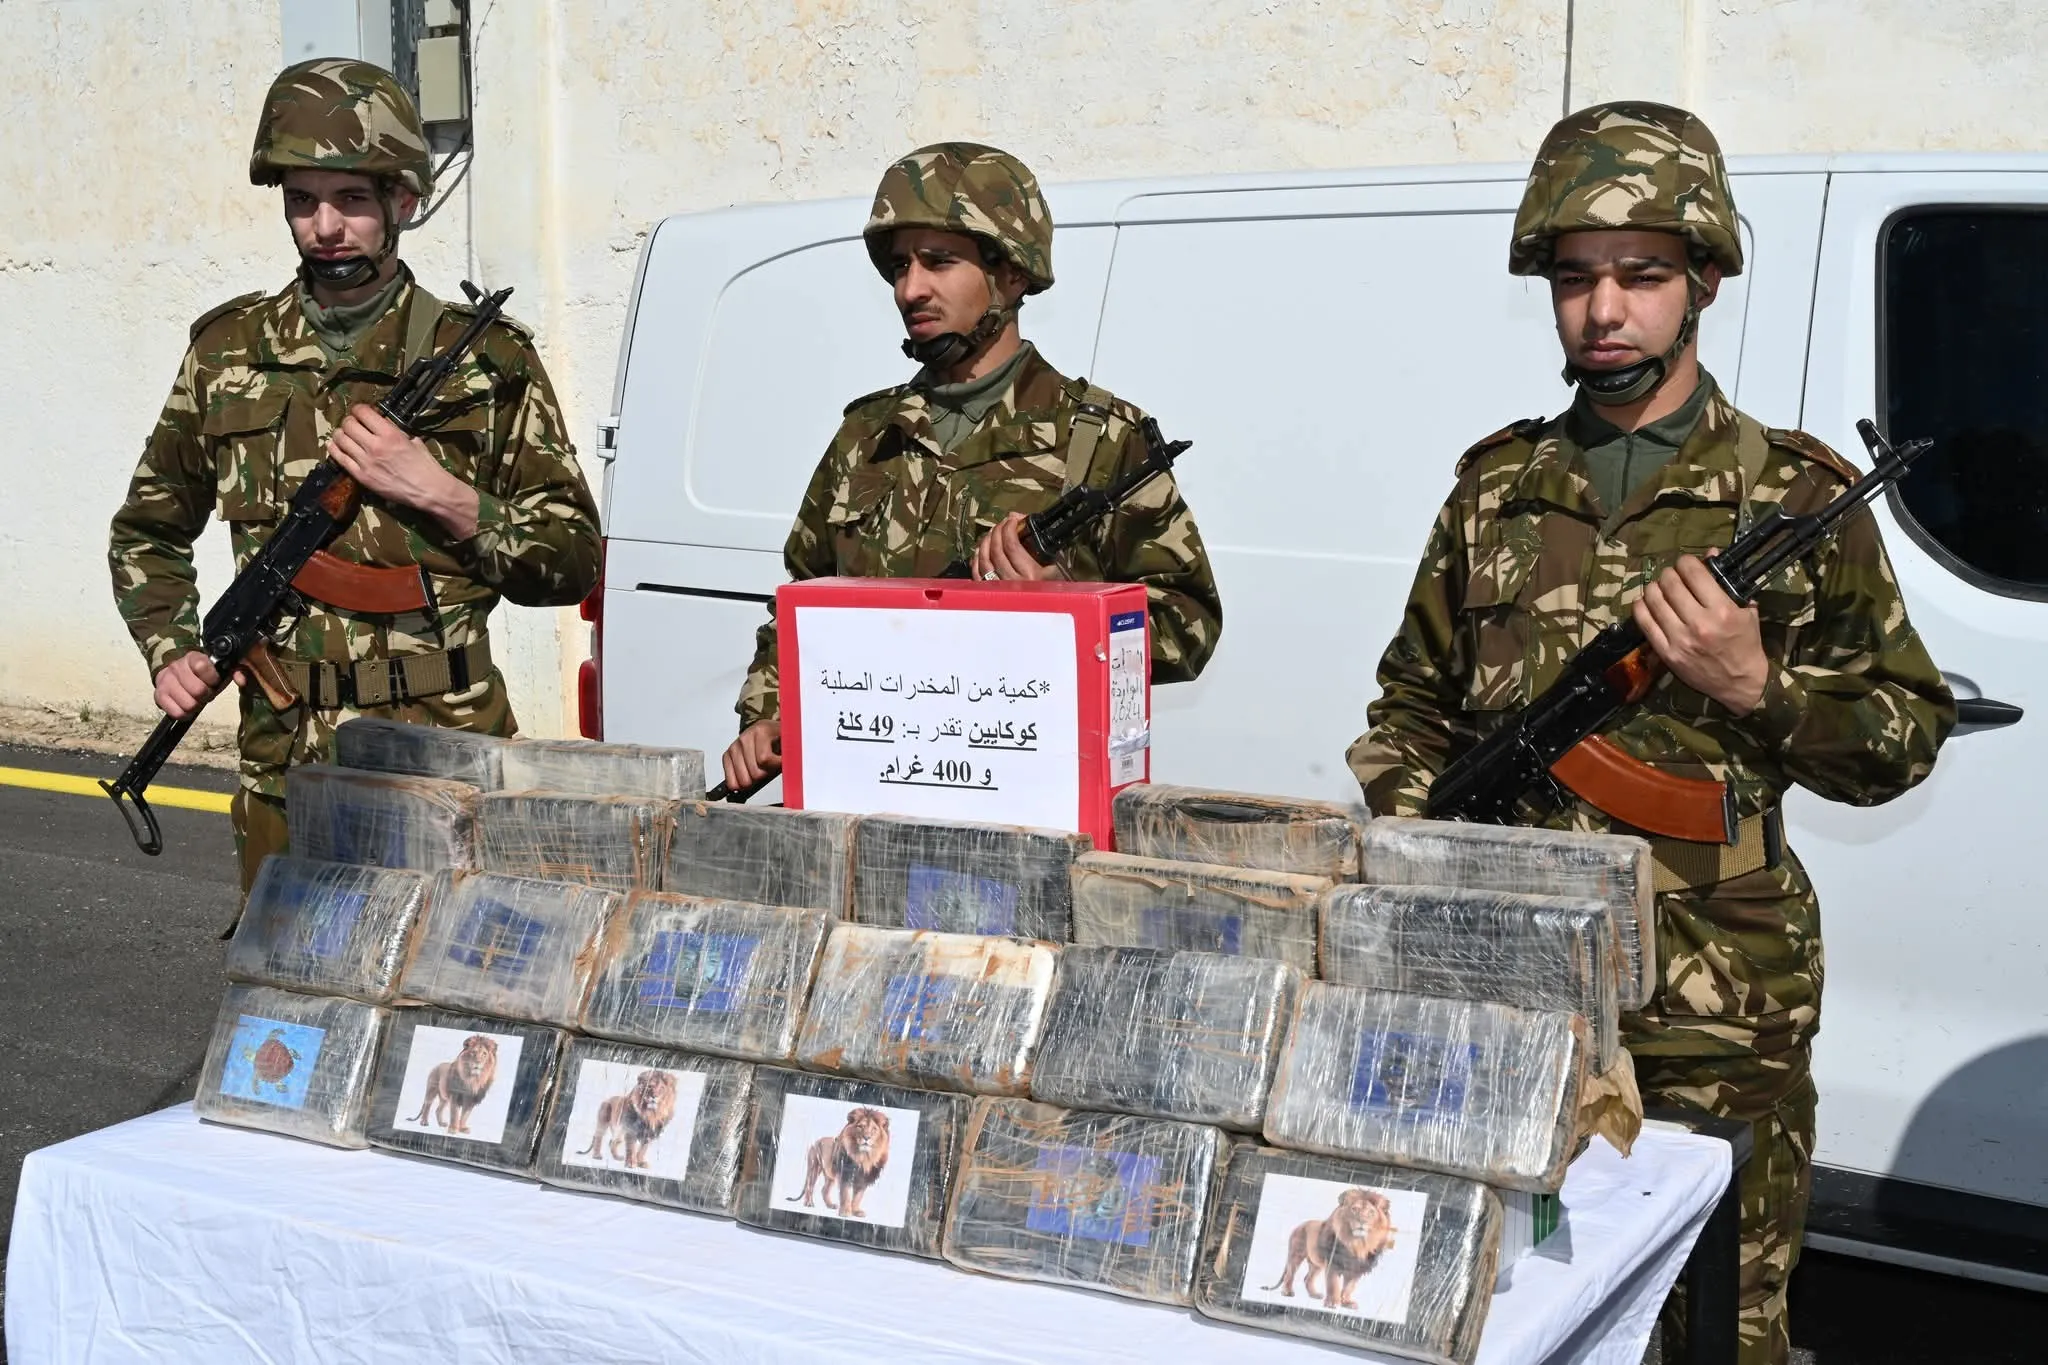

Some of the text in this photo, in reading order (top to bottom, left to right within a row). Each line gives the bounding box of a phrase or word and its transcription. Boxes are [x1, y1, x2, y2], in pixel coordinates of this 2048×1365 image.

[820, 669, 874, 697] الصلبة
[880, 675, 961, 700] المخدرات
[967, 682, 994, 704] من
[836, 711, 863, 738] كلغ
[868, 714, 895, 737] 49
[928, 717, 963, 743] تقدر
[968, 719, 1038, 749] كوكايين
[932, 759, 972, 783] 400
[979, 768, 993, 786] و
